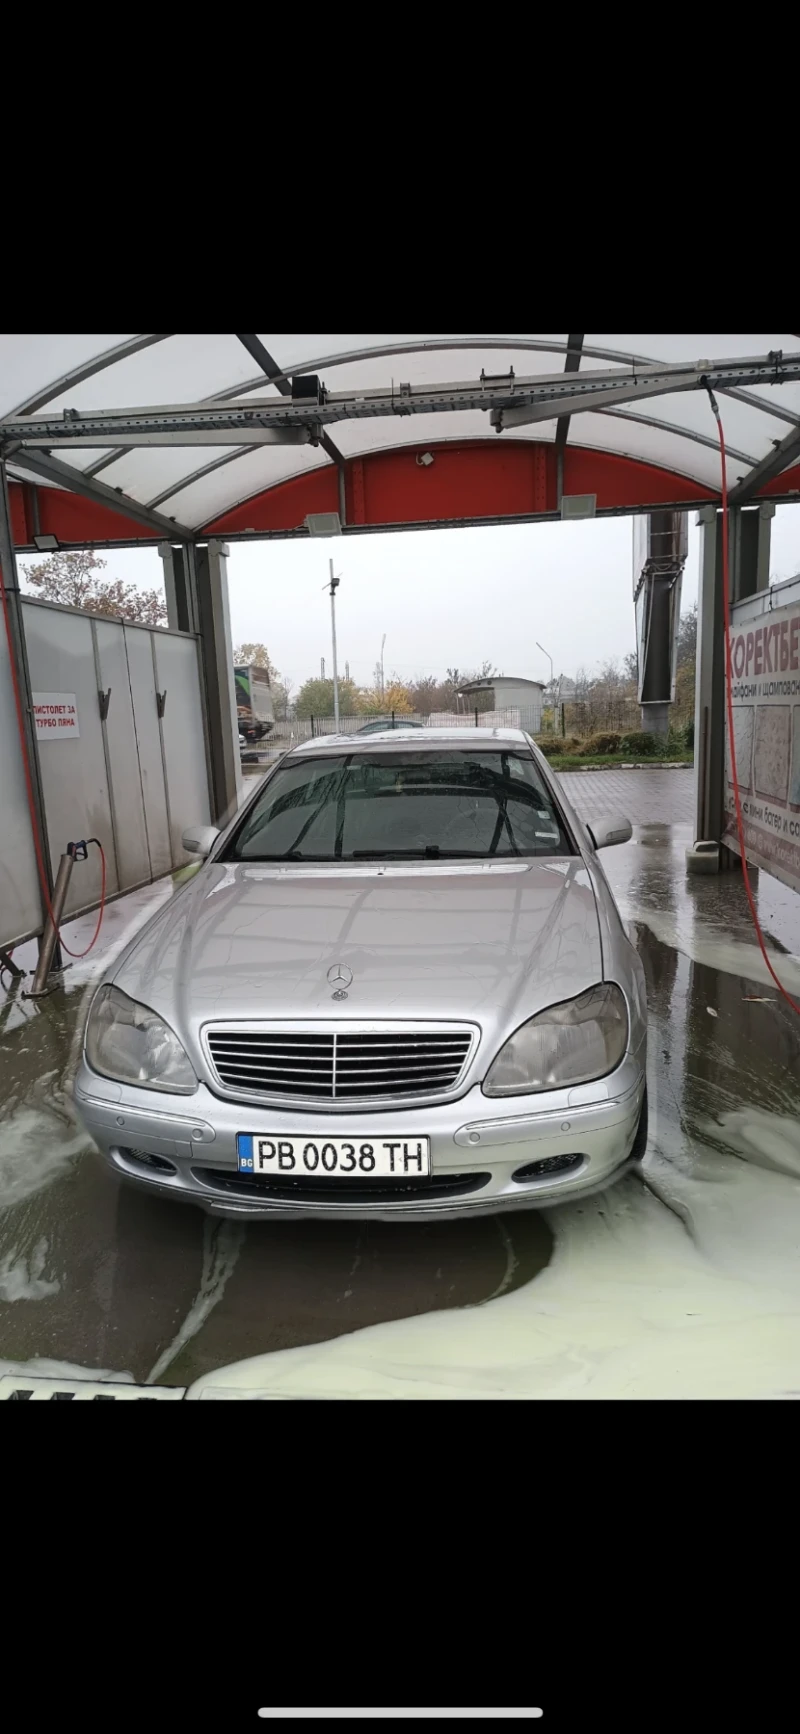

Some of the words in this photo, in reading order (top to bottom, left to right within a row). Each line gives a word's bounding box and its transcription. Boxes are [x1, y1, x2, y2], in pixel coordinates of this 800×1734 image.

[729, 617, 800, 679] КОРЕКТБЕ
[33, 705, 66, 714] ПИСТОЛЕТ
[67, 705, 75, 714] ЗА
[36, 718, 57, 728] ТУРБО
[58, 718, 75, 727] ПЯНА
[764, 806, 782, 833] багер
[782, 817, 788, 833] и
[241, 1158, 253, 1168] BG
[258, 1141, 296, 1170] PB
[303, 1142, 376, 1172] 0038
[383, 1142, 423, 1172] TH
